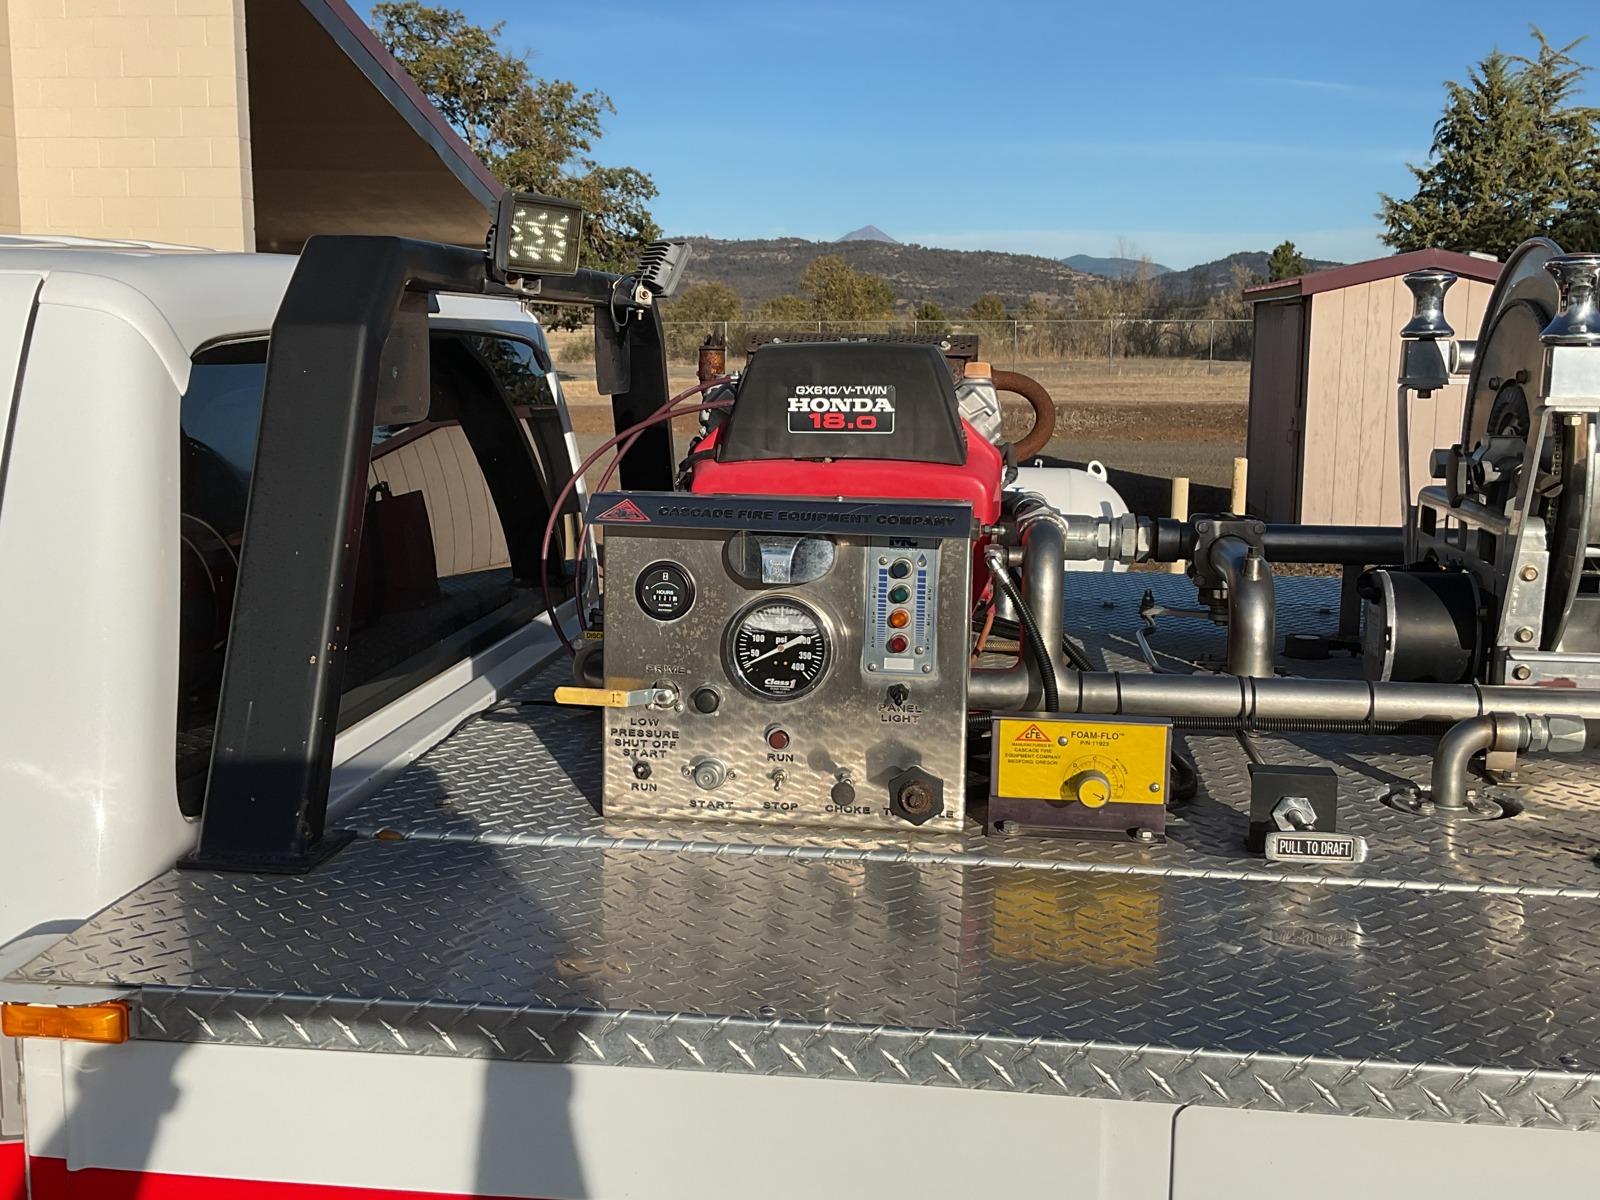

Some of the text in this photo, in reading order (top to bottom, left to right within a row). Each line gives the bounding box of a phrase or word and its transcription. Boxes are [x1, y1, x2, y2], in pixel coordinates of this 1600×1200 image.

[795, 385, 888, 395] GX610/V-TWIN
[787, 397, 896, 413] HONDA
[808, 412, 877, 429] 18.0
[658, 506, 956, 527] CASCADE FIRE EQUIPMENT COMPANY
[752, 634, 765, 643] 100
[775, 635, 788, 645] psi
[750, 649, 760, 657] 50
[798, 651, 812, 660] 350
[645, 663, 687, 674] PRIME
[791, 662, 805, 671] 400
[878, 703, 922, 713] PANEL
[630, 717, 660, 727] LOW
[880, 714, 919, 723] LIGHT
[610, 728, 680, 739] PRESSURE
[614, 738, 677, 750] SHUT OFF
[623, 748, 667, 758] START
[767, 752, 794, 762] RUN
[631, 782, 658, 792] RUN
[689, 799, 734, 809] START
[763, 801, 799, 811] STOP
[824, 804, 871, 815] CHOKE
[1279, 839, 1350, 856] PULL TO DRAFT
